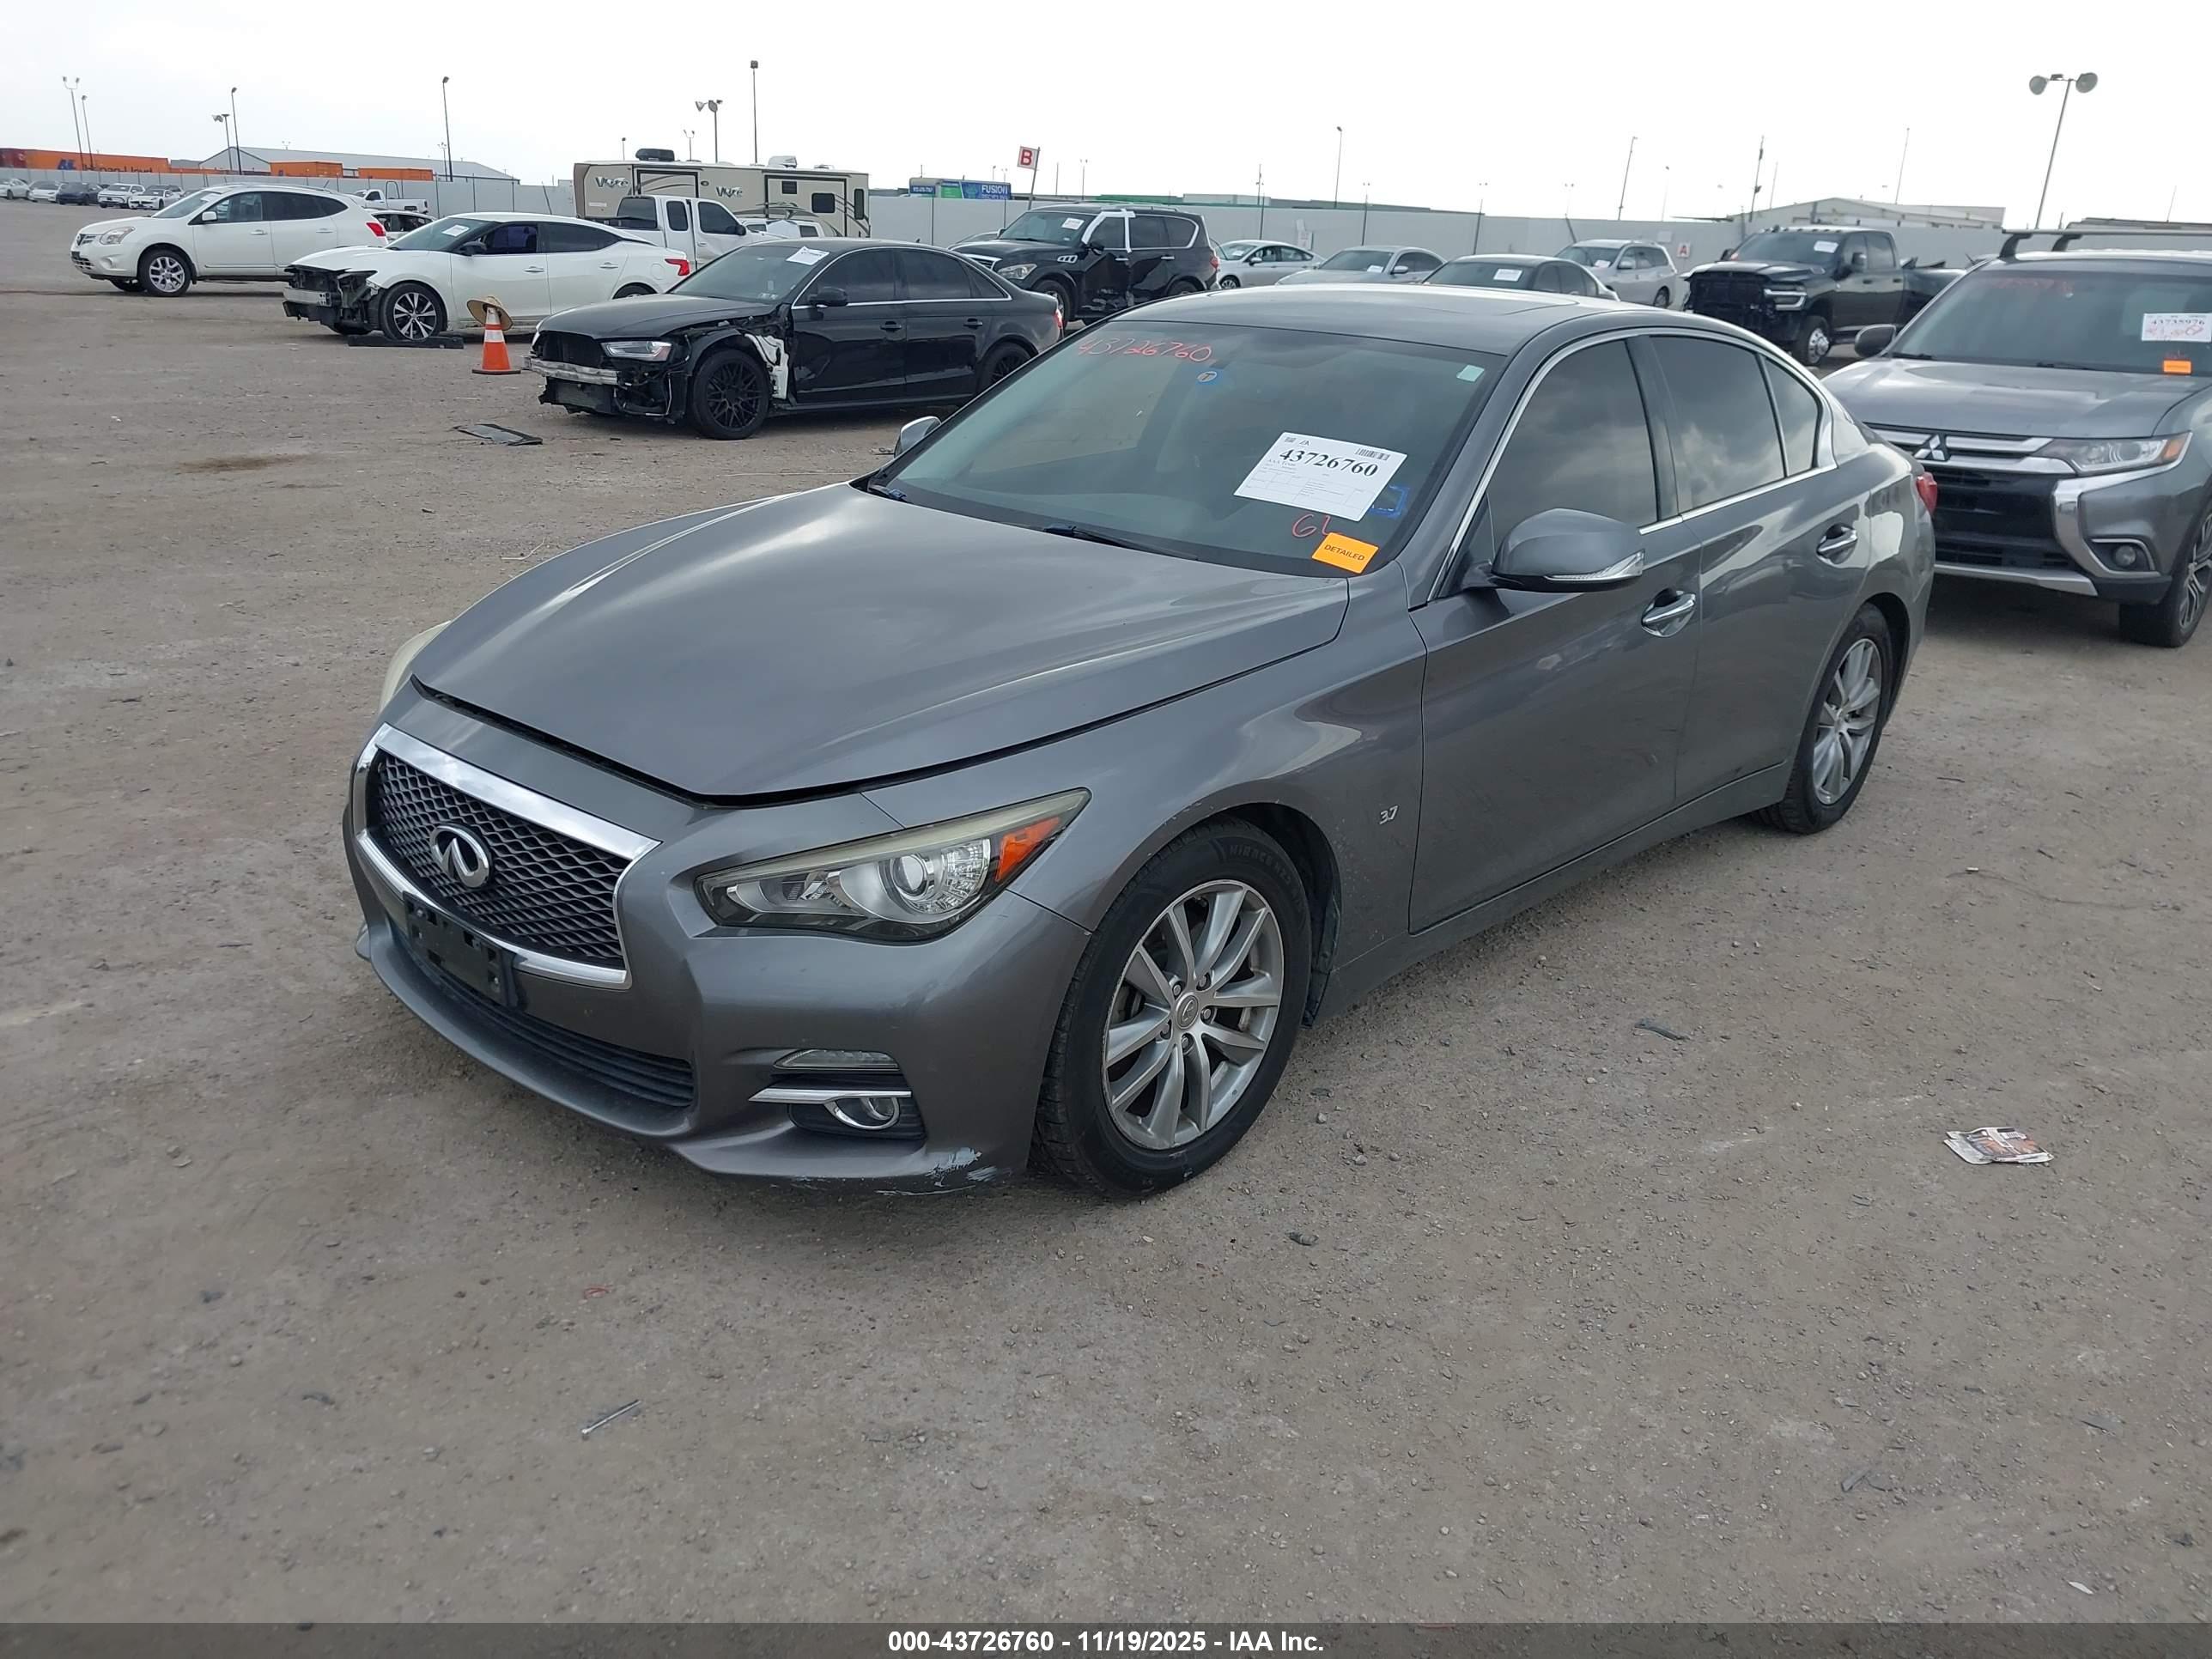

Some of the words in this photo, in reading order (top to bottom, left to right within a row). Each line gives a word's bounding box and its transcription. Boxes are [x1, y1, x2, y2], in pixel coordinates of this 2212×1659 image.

[1021, 149, 1032, 166] B
[981, 185, 1008, 194] FUSION
[1279, 449, 1378, 477] 43726760
[1324, 544, 1365, 561] DETAILED
